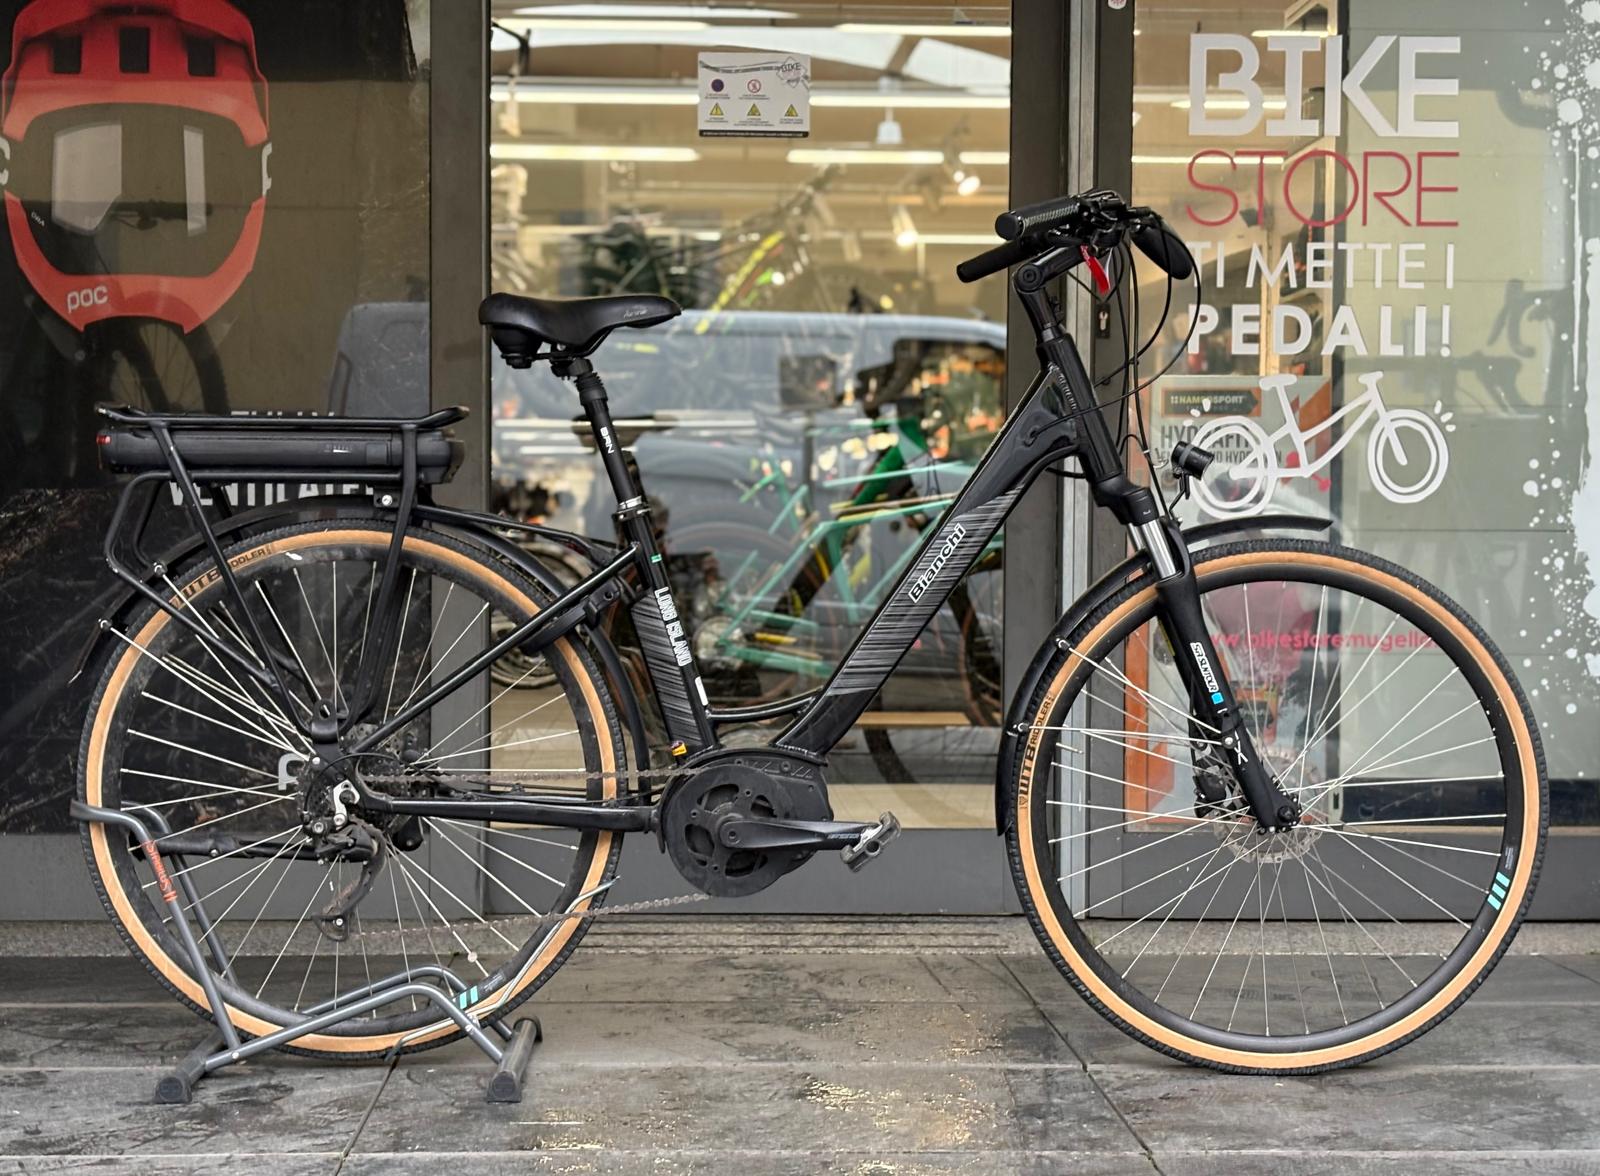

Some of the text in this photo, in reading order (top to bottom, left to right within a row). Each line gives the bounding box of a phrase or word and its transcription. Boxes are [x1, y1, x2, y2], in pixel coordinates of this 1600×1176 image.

[1189, 33, 1460, 137] BIKE
[1186, 149, 1459, 227] STORE
[1186, 241, 1454, 289] TI METTE I
[1187, 304, 1450, 357] PEDALI!
[600, 427, 615, 453] BRN
[231, 549, 266, 568] DDLER
[908, 523, 966, 603] Bianchi
[654, 587, 678, 621] LONG
[666, 620, 693, 666] ISLAND
[1199, 658, 1218, 692] SUNTOUR
[1029, 701, 1051, 745] RIDDLER
